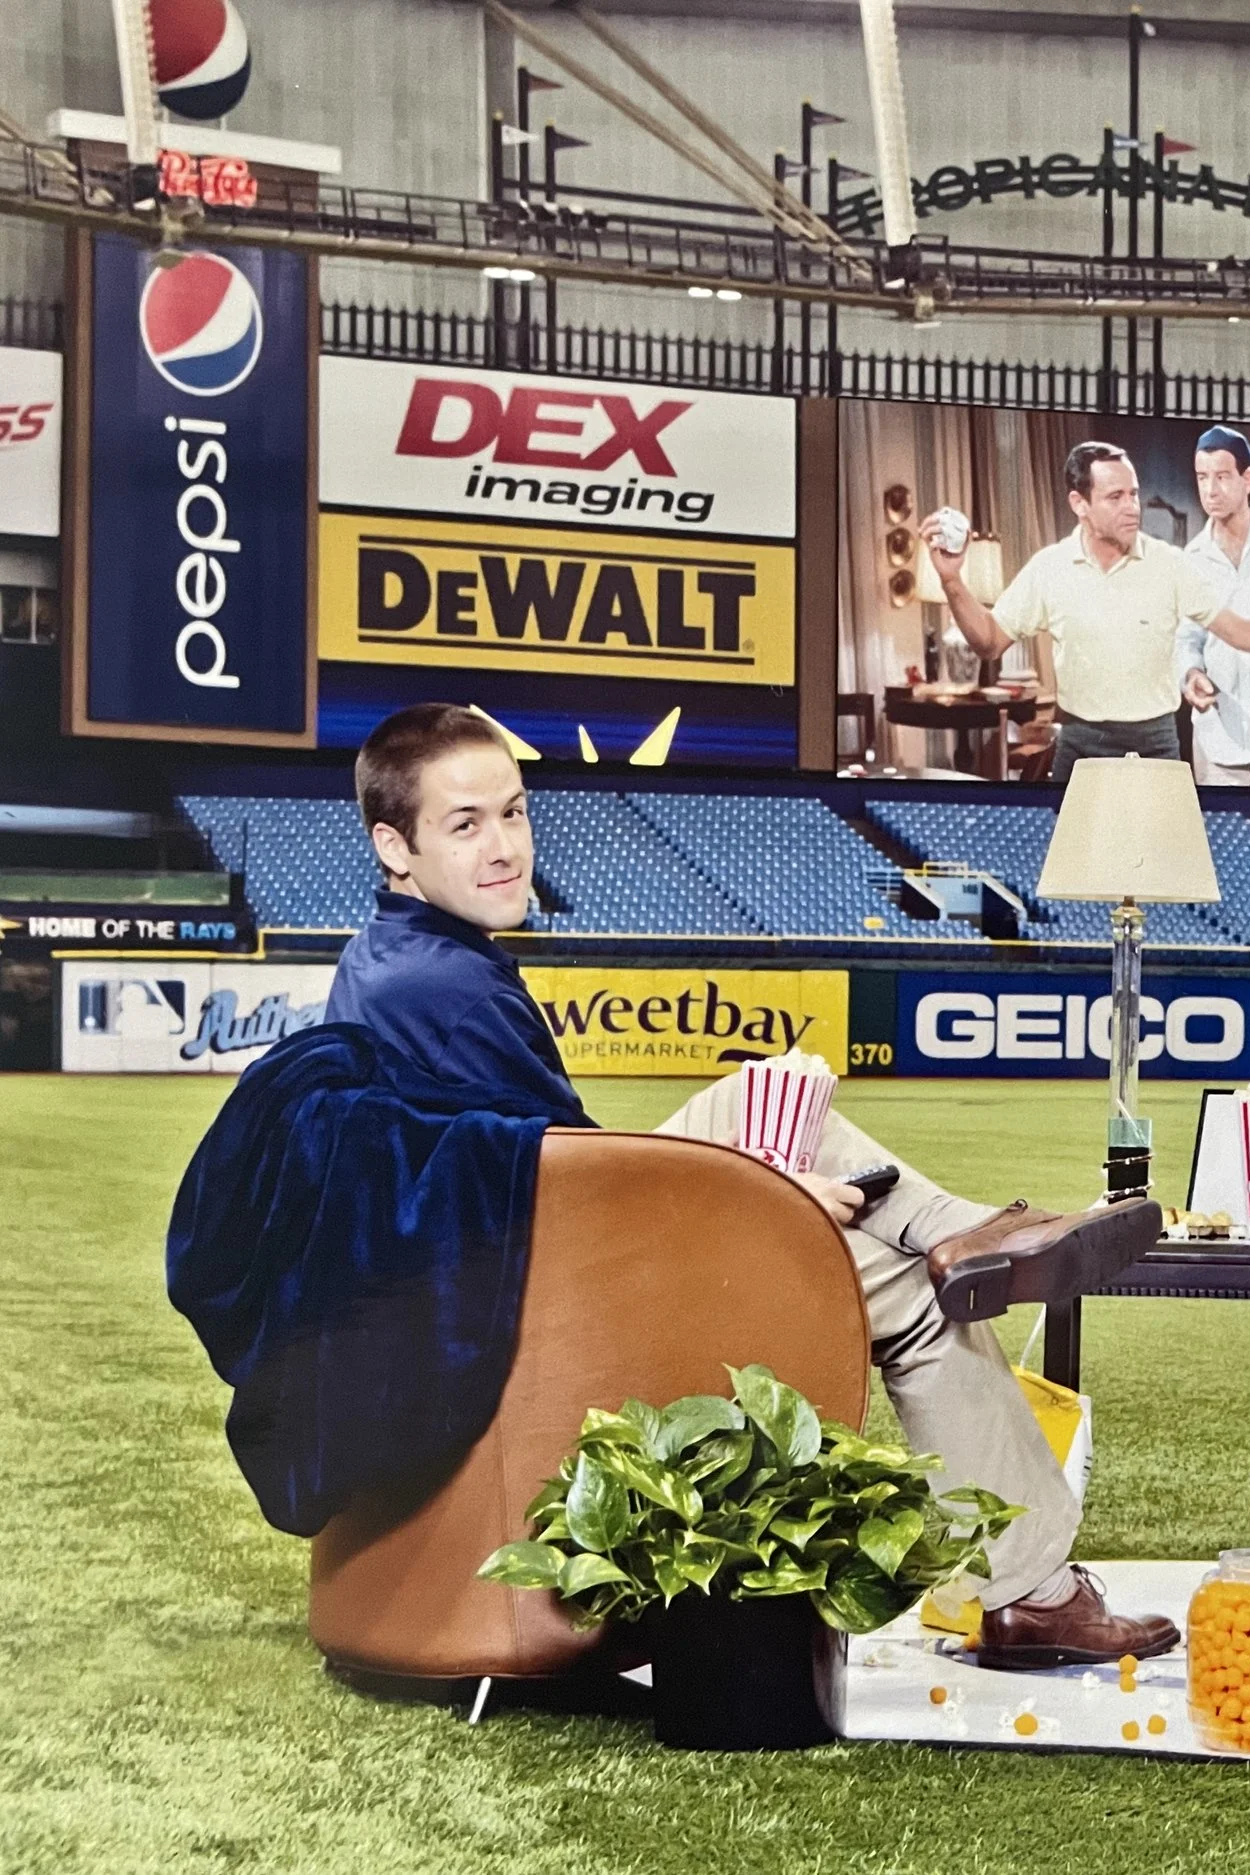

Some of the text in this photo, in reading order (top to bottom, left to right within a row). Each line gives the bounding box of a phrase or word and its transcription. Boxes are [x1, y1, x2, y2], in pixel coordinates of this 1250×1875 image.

[395, 377, 695, 478] DEX
[464, 465, 715, 523] imaging
[164, 415, 242, 689] pepsi
[28, 917, 237, 940] HOME OF THE RAYS
[180, 989, 328, 1061] Authe
[540, 980, 817, 1063] weetbay
[563, 1040, 717, 1060] UPERMARKET
[850, 1043, 894, 1067] 370
[915, 991, 1245, 1063] GEICO
